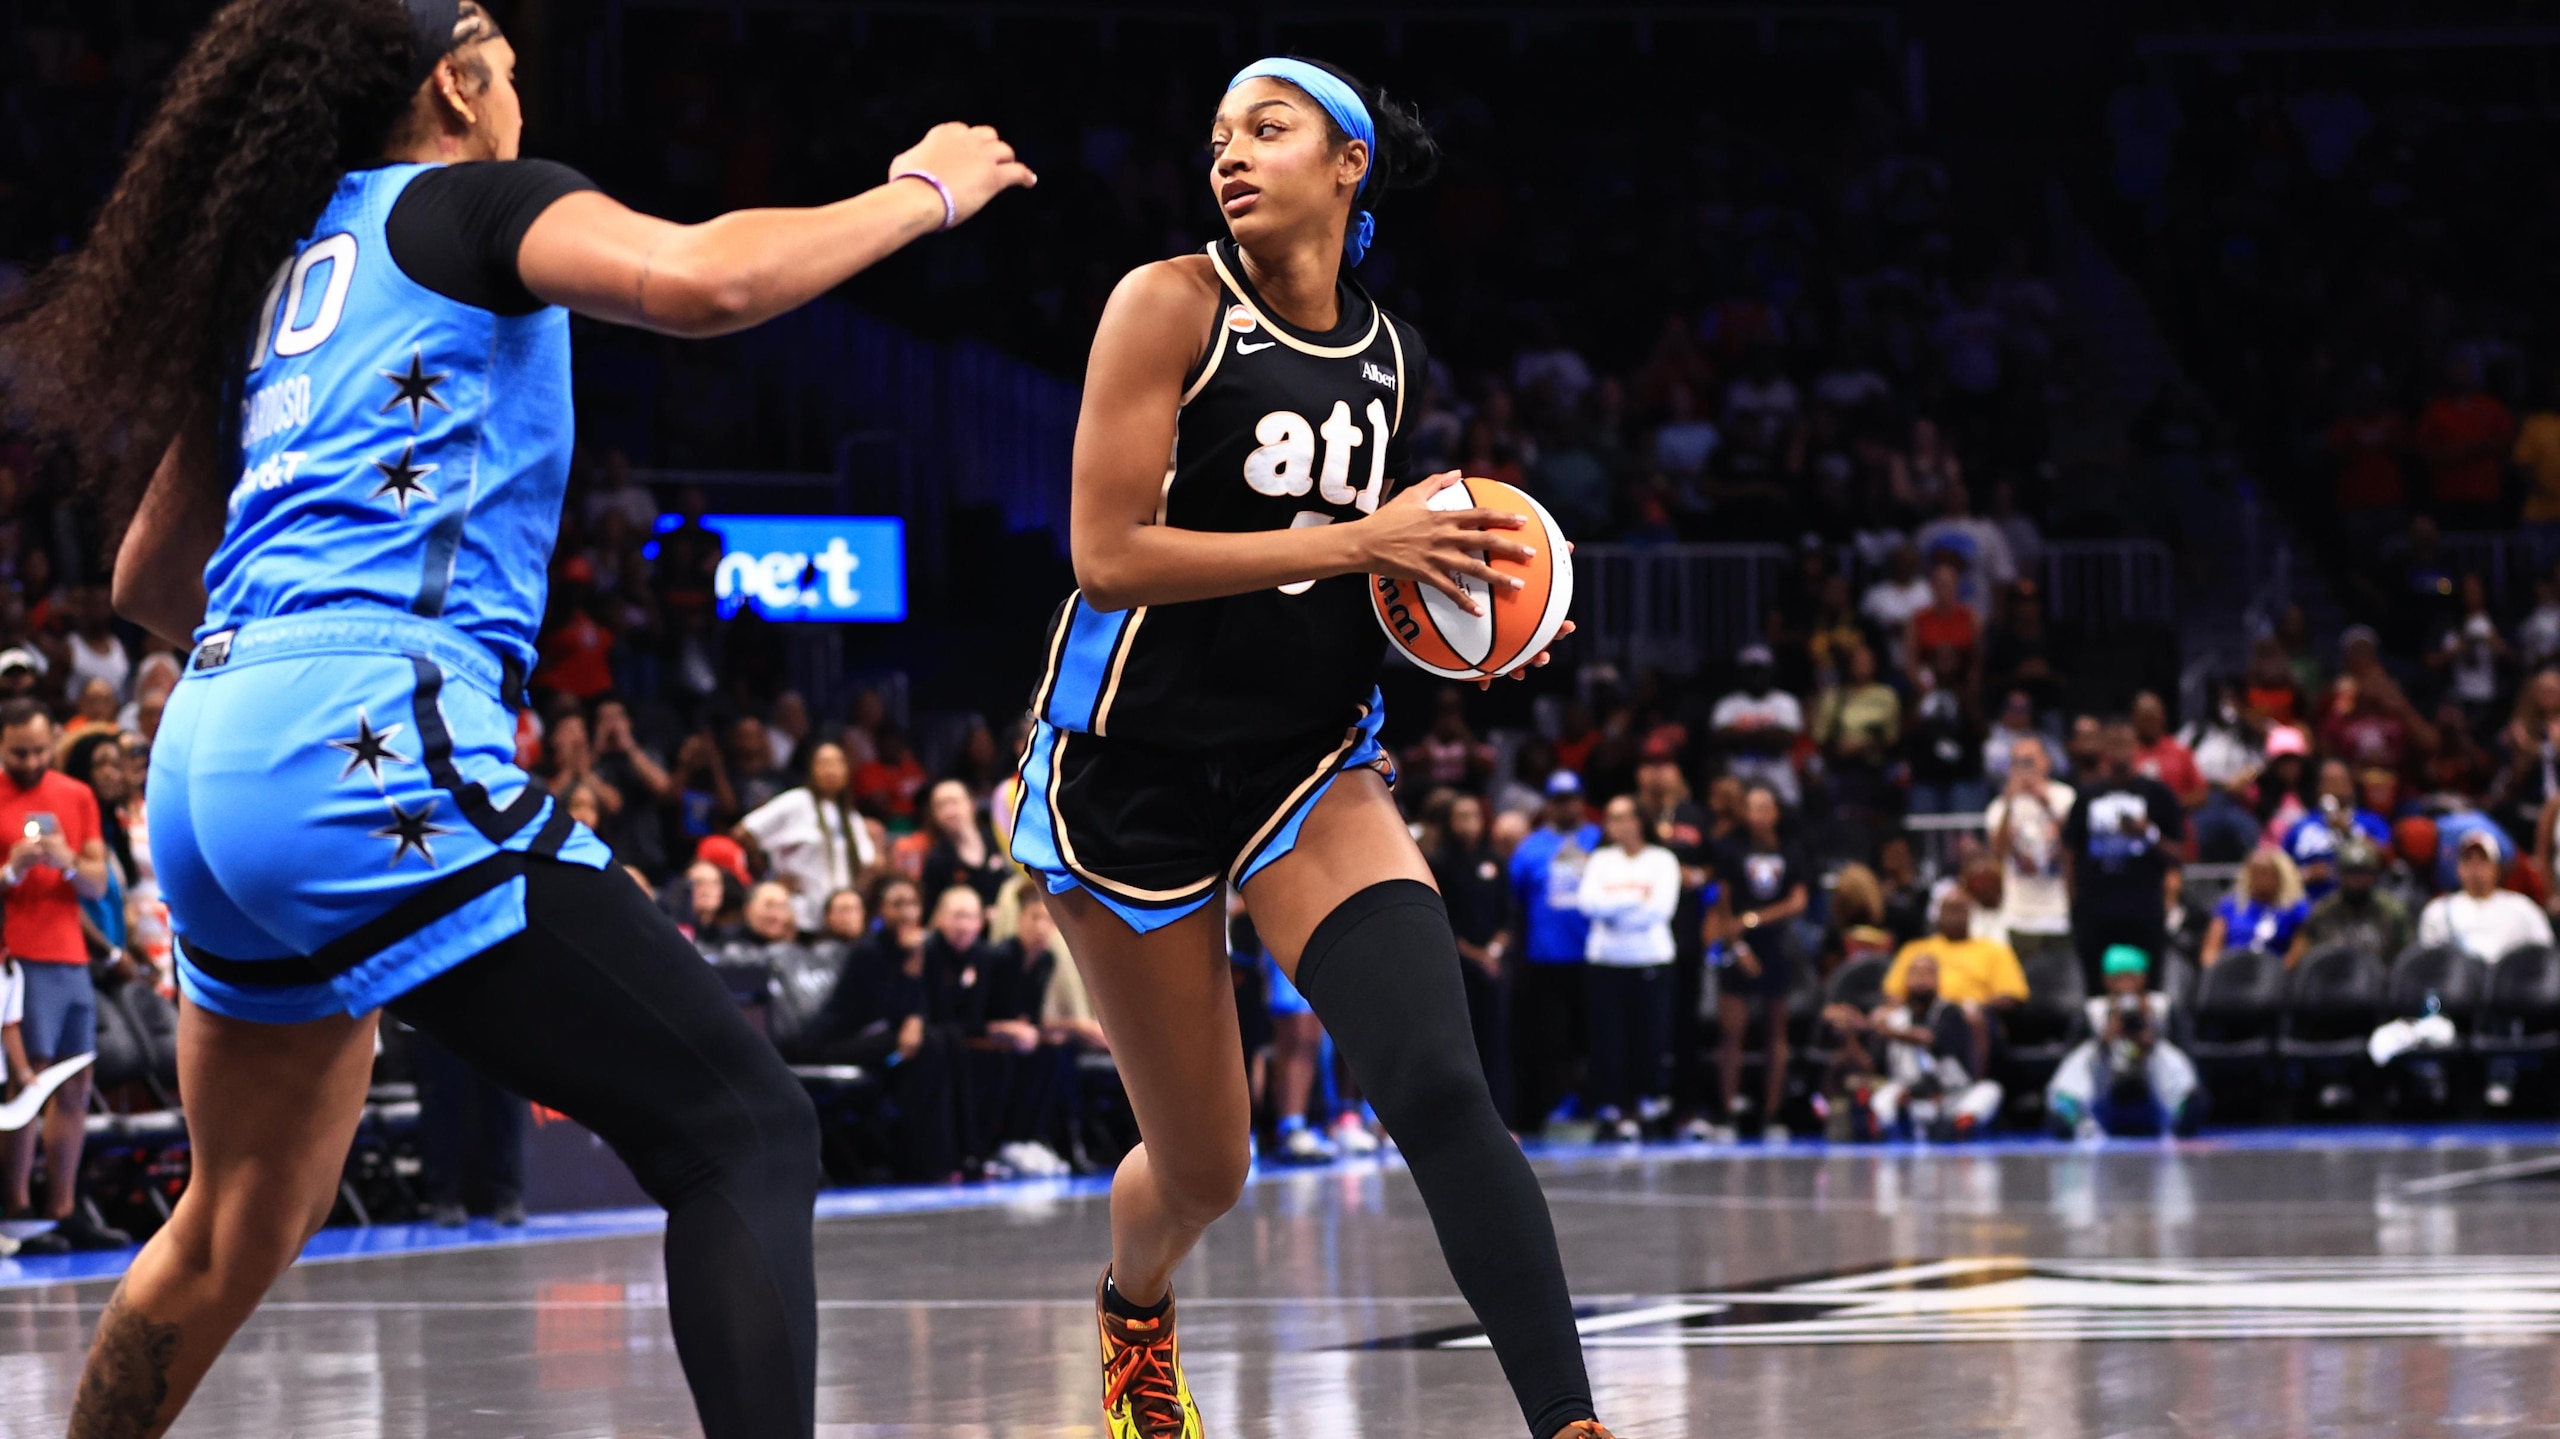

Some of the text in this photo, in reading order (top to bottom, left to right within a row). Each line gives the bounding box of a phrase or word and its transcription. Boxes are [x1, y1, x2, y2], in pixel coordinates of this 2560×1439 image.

[249, 231, 358, 372] 10
[1362, 361, 1396, 391] Albert
[1243, 397, 1390, 515] atl
[1377, 575, 1421, 647] Wil
